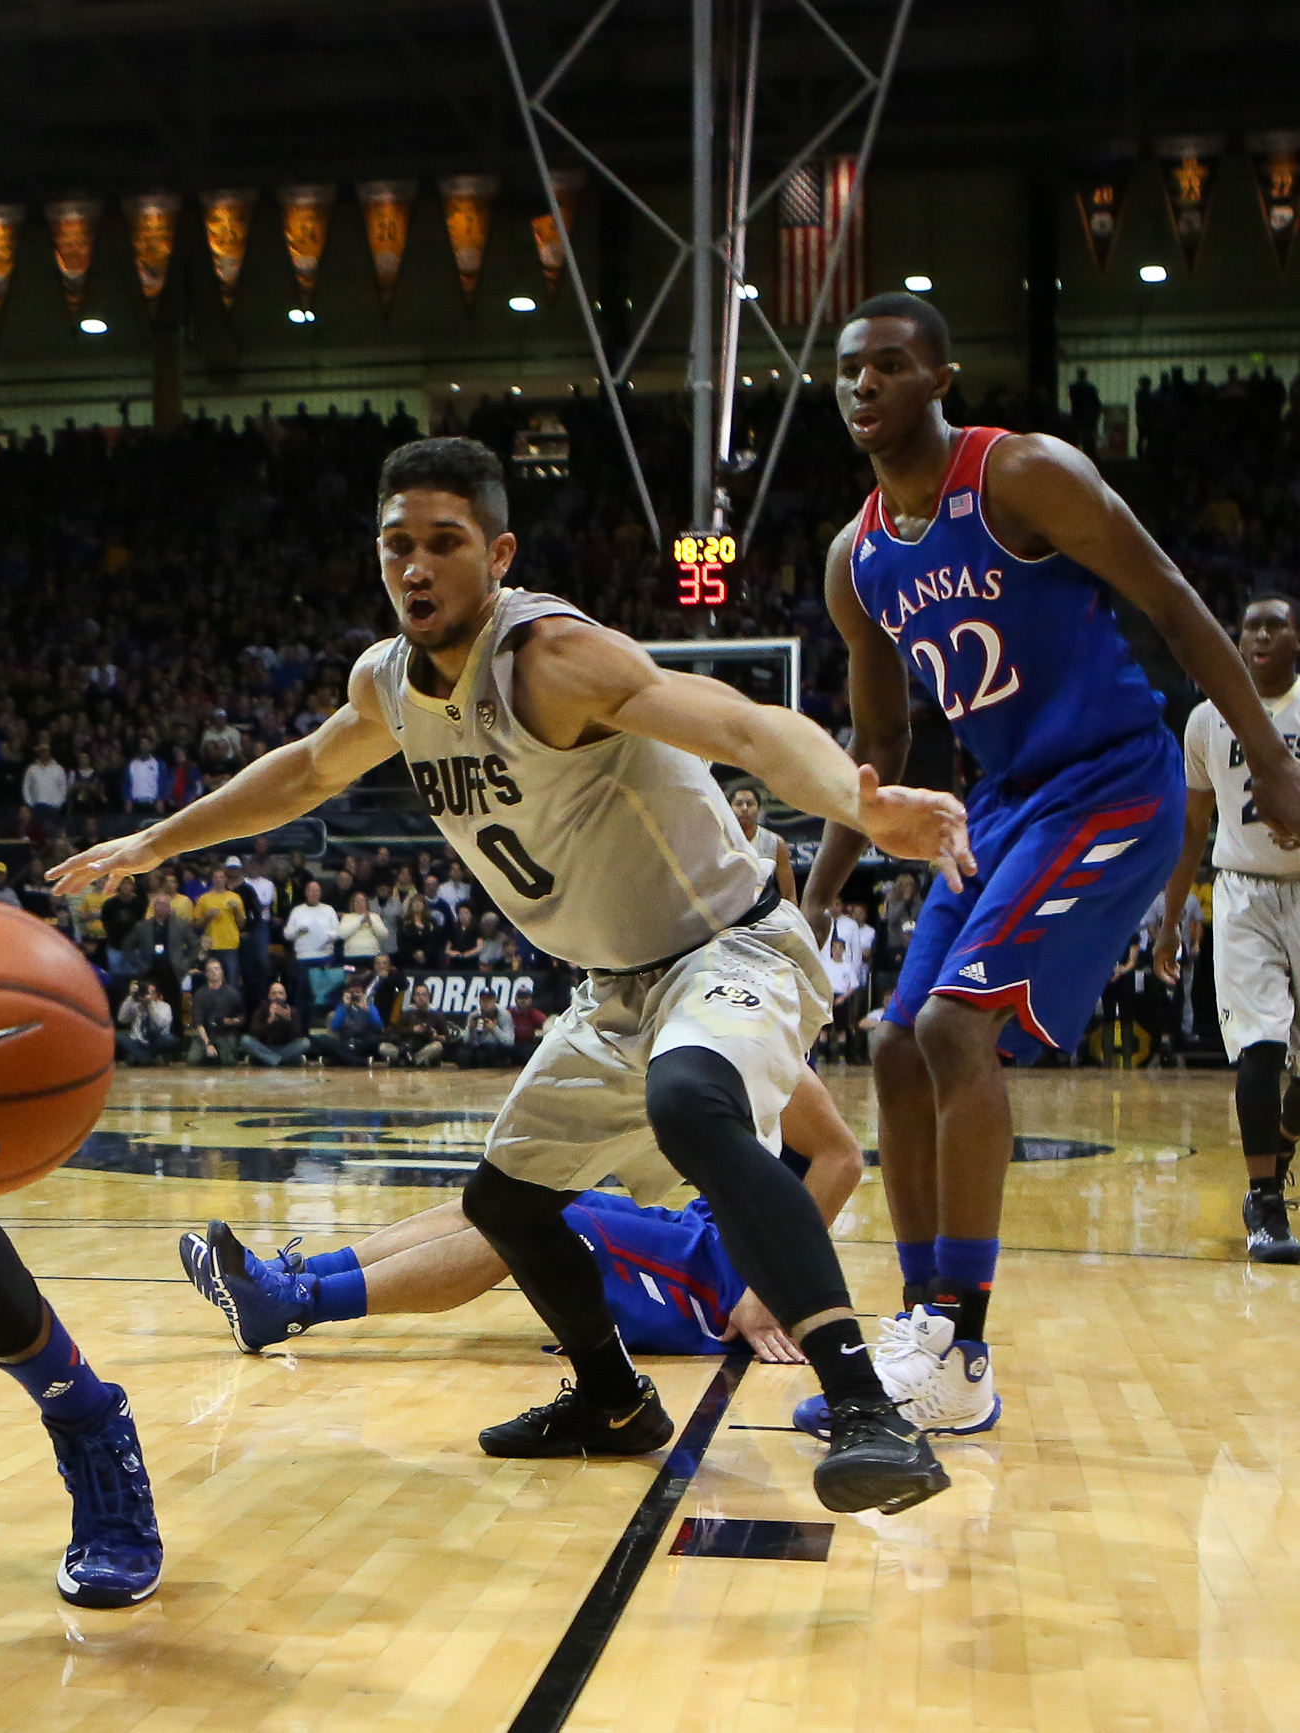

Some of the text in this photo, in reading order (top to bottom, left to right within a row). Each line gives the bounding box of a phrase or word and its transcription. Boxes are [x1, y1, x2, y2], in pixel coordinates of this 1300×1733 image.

[674, 535, 736, 564] 18:20
[679, 562, 726, 605] 35
[880, 566, 1003, 645] KANSAS
[910, 619, 1021, 721] 22
[411, 754, 523, 816] BUFFS
[476, 823, 555, 900] 0
